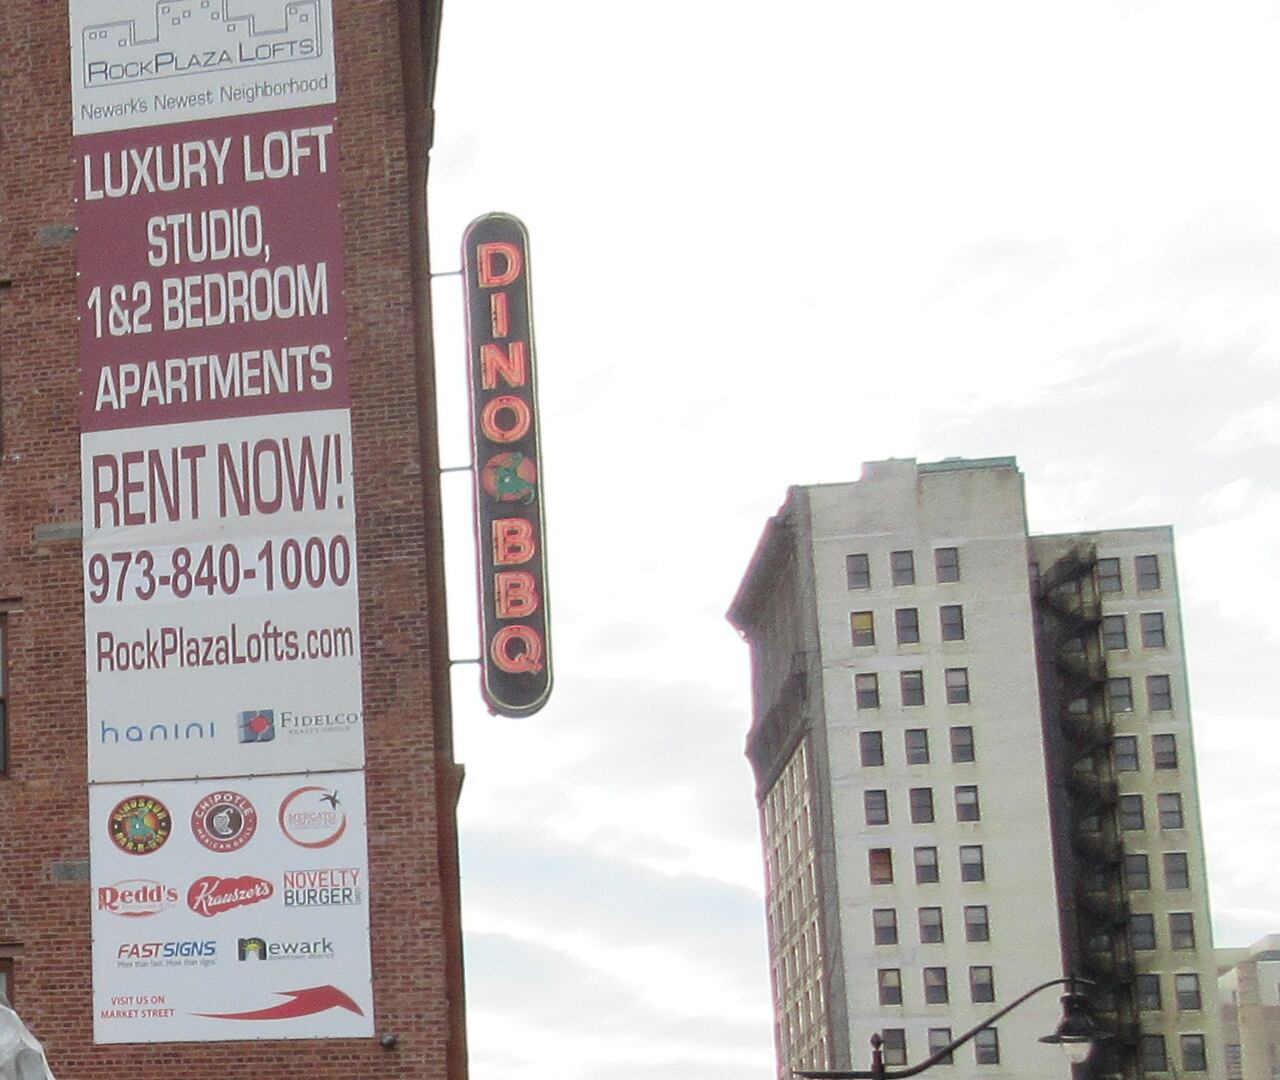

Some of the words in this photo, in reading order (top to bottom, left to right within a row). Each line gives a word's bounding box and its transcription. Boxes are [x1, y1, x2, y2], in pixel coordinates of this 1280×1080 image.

[239, 38, 316, 63] LOFTS
[154, 90, 213, 112] Newest
[220, 74, 329, 104] Neighborhood
[83, 137, 232, 200] LUXURY
[243, 125, 333, 182] LOFT
[146, 205, 270, 267] STUDIO,
[87, 281, 152, 338] 1&2
[162, 262, 329, 331] BEDROOM
[476, 242, 531, 444] DINO
[94, 344, 333, 412] APARTMENTS
[92, 445, 206, 529] RENT
[217, 433, 344, 518] NOW!
[89, 535, 351, 604] 973-840-1000
[491, 517, 543, 674] BBQ
[96, 620, 354, 672] RockPlazaLofts.com
[101, 720, 215, 744] hanini
[195, 793, 254, 818] CHIPOTLE
[98, 885, 178, 910] Redd's
[193, 879, 269, 916] Krauszer's
[283, 870, 360, 888] NOVELTY
[284, 888, 353, 905] BURGER
[101, 1010, 138, 1018] MARKET
[141, 1008, 175, 1017] STREET
[111, 996, 133, 1005] VISIT
[136, 996, 149, 1004] US
[151, 995, 165, 1004] ON
